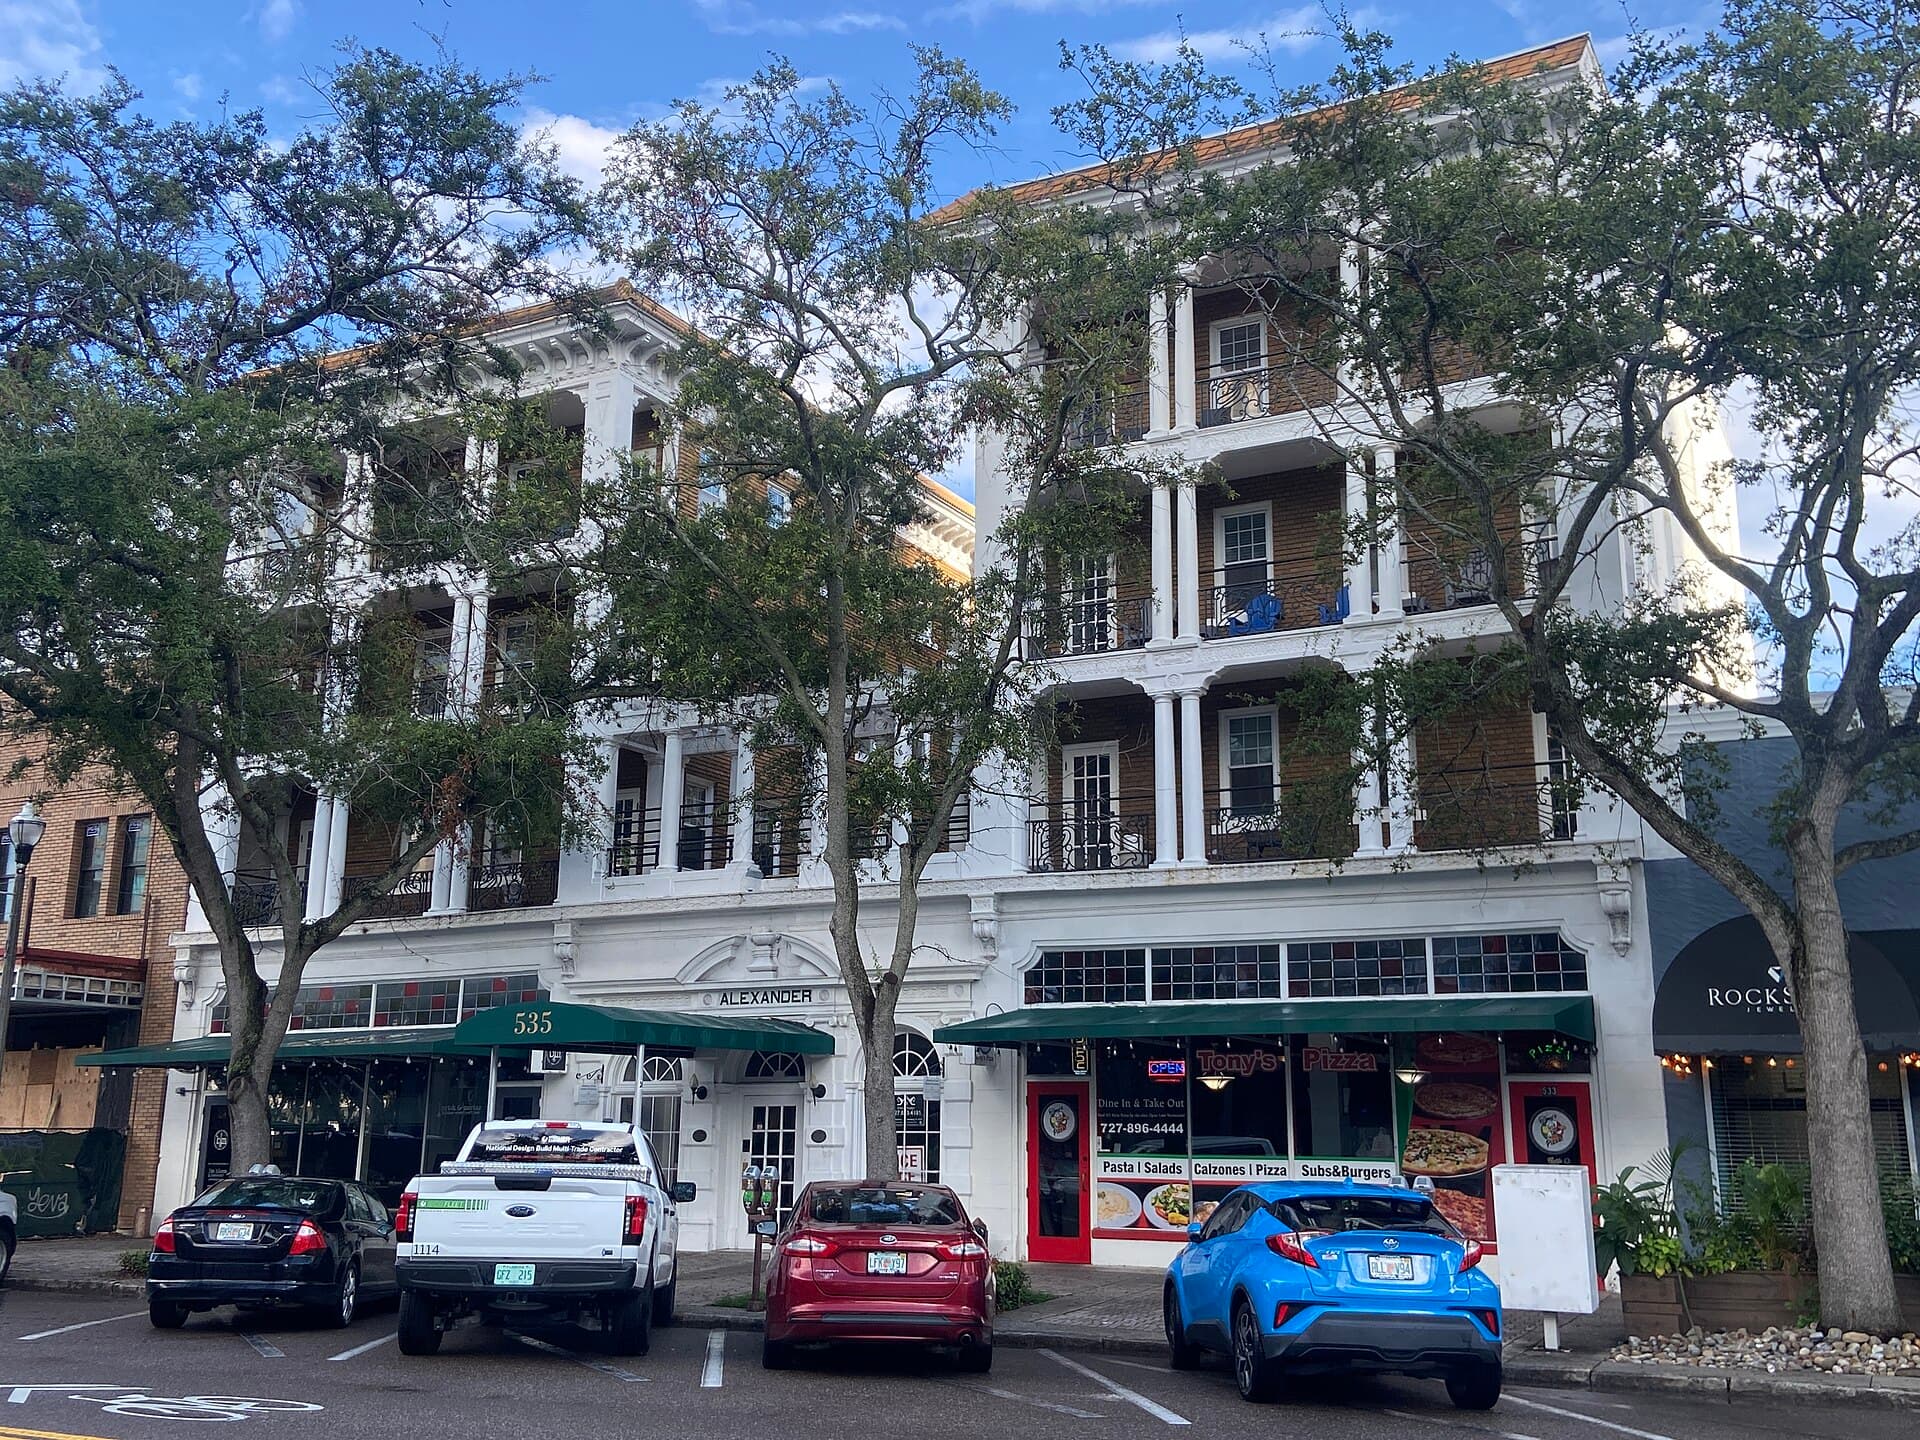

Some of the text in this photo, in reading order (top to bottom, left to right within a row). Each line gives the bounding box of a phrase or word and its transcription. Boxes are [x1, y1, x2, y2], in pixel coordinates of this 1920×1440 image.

[720, 990, 812, 1006] ALEXANDER
[514, 1011, 552, 1034] 535
[1150, 1062, 1185, 1074] OPEN
[1196, 1048, 1377, 1076] Tony's Pizza
[1542, 1087, 1557, 1096] 533
[1098, 1098, 1184, 1108] Dine In & Take Out
[1100, 1123, 1184, 1134] 727-896-4444
[589, 1145, 623, 1153] Contractor
[1103, 1161, 1134, 1173] Pasta
[1144, 1162, 1183, 1174] Salads
[1194, 1163, 1246, 1176] Calzones
[1256, 1164, 1287, 1176] Pizza
[1301, 1165, 1391, 1180] Subs&Burgers
[414, 1244, 440, 1255] 1114
[518, 1269, 533, 1281] 215
